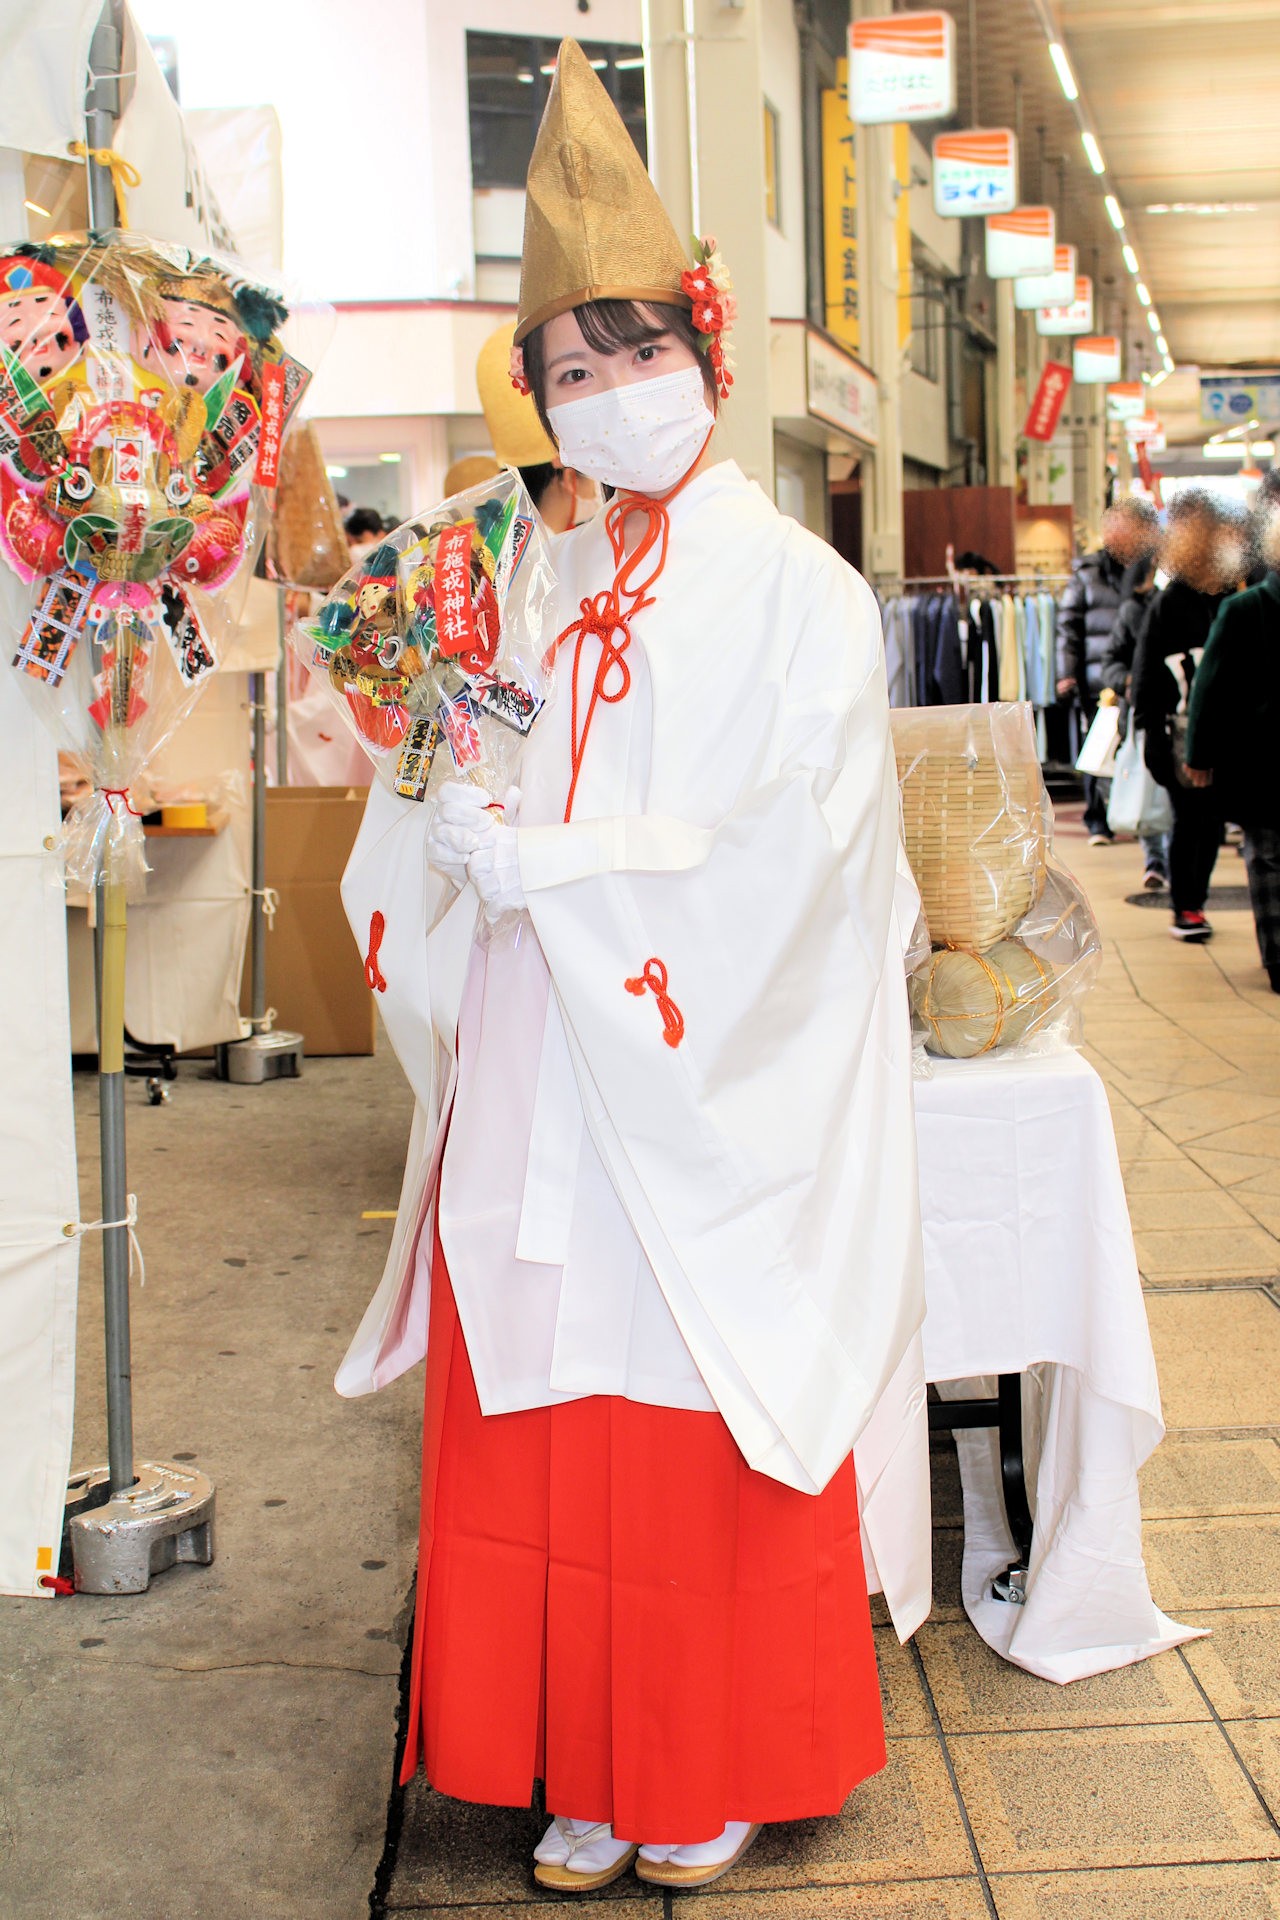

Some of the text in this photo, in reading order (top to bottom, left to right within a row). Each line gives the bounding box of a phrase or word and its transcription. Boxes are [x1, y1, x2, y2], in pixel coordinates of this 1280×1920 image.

[942, 181, 1004, 200] ライト
[261, 380, 282, 476] 布施戎神社
[441, 533, 470, 641] 布施戎神社
